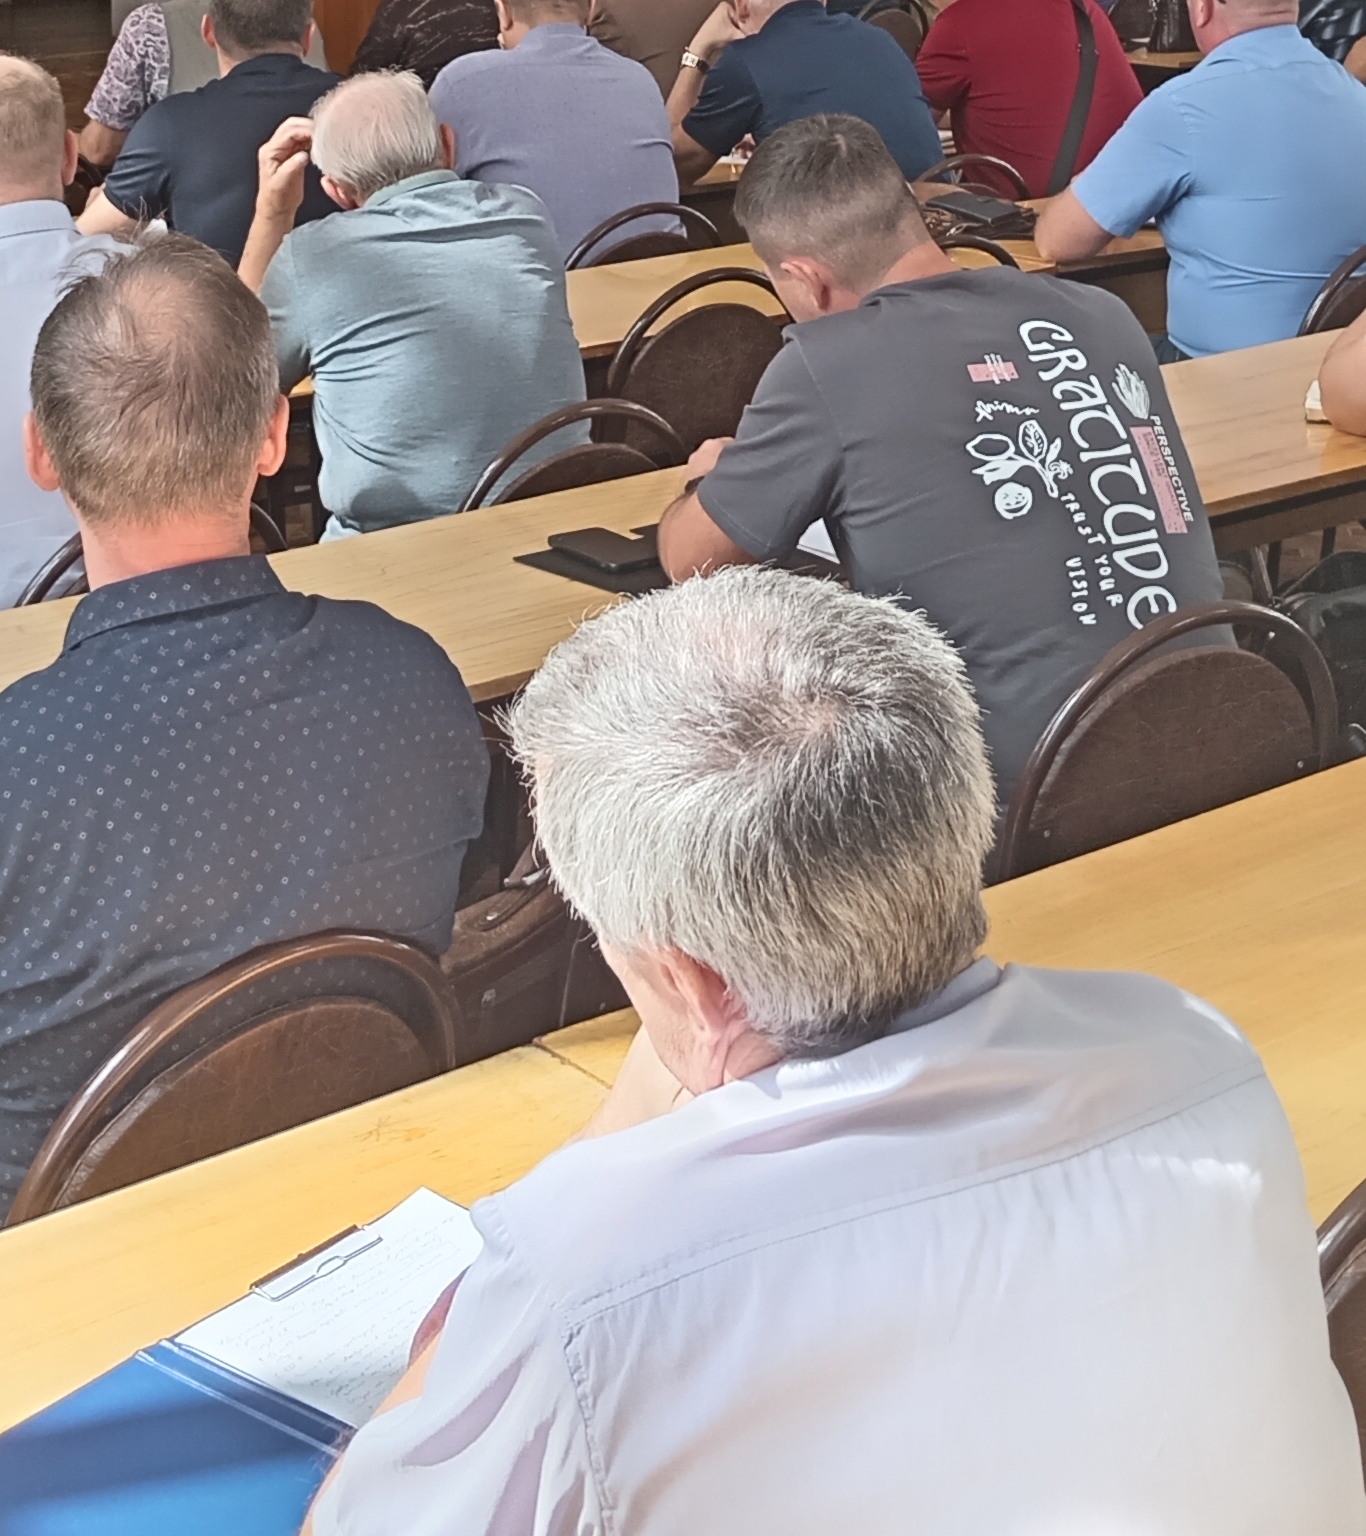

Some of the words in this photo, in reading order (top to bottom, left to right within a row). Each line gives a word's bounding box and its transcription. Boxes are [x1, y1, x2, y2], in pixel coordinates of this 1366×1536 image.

[1149, 415, 1194, 522] PERSPECTIVE
[1060, 492, 1107, 544] TRUST
[1094, 554, 1124, 607] YOUR
[1065, 556, 1097, 624] VISION
